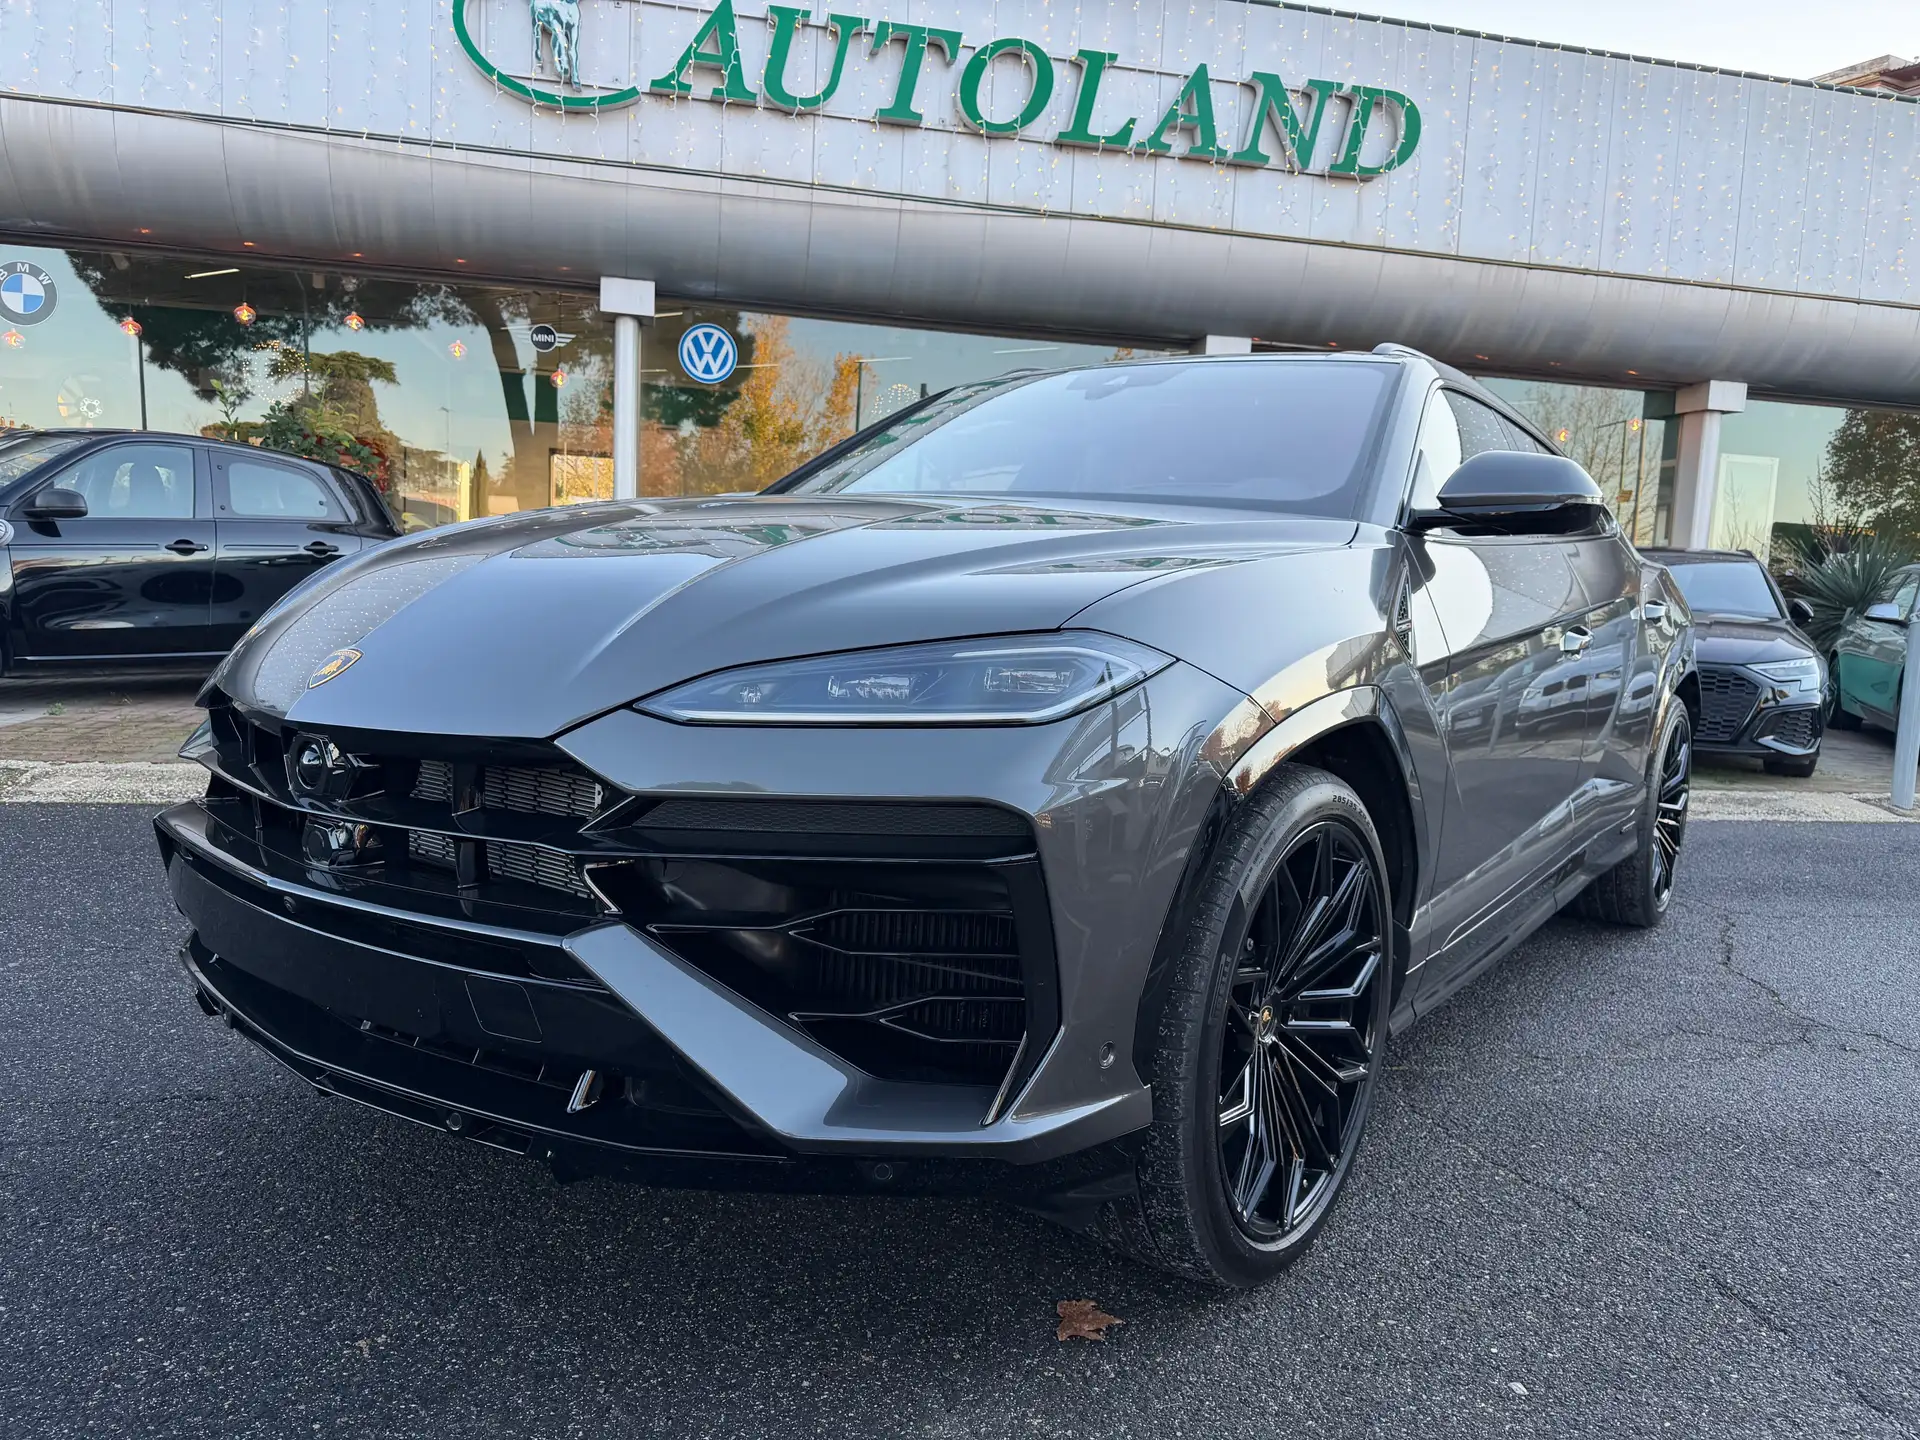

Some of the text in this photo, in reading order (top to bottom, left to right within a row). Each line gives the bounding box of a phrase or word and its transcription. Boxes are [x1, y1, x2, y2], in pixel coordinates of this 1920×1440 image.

[649, 0, 1421, 176] AUTOLAND
[0, 262, 52, 285] BMW
[532, 333, 555, 343] MINI
